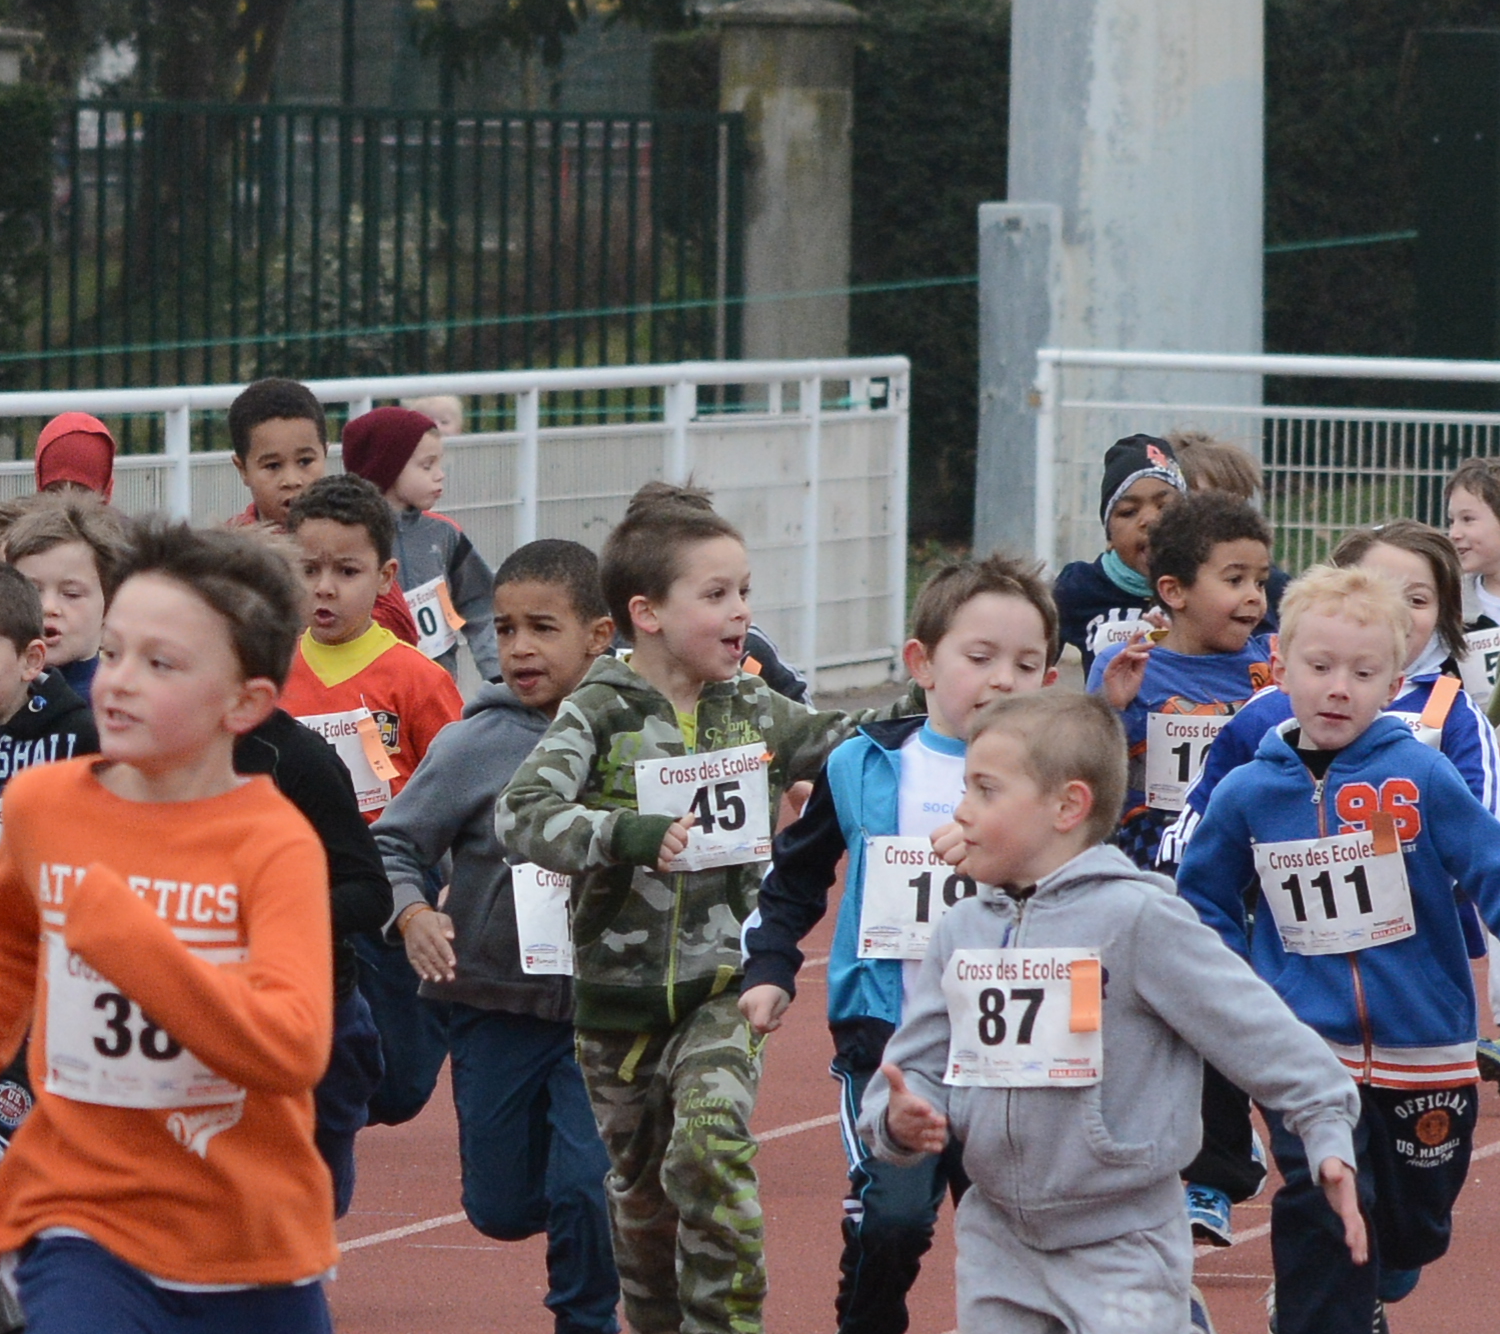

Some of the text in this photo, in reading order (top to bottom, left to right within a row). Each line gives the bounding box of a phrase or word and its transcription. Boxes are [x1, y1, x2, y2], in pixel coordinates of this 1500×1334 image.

[417, 606, 438, 641] 0
[323, 719, 358, 739] Ecoles
[1166, 722, 1199, 738] Cross
[660, 753, 760, 785] Cross des Ecoles
[676, 780, 746, 834] 45
[1335, 778, 1422, 843] 96
[885, 845, 924, 865] Cross
[1269, 840, 1375, 870] Cross des Ecoles
[1281, 865, 1373, 922] 111
[957, 958, 1071, 981] Cross des Ecoles
[93, 992, 183, 1060] 38
[978, 987, 1045, 1046] 87
[1394, 1091, 1468, 1119] OFFICIAL
